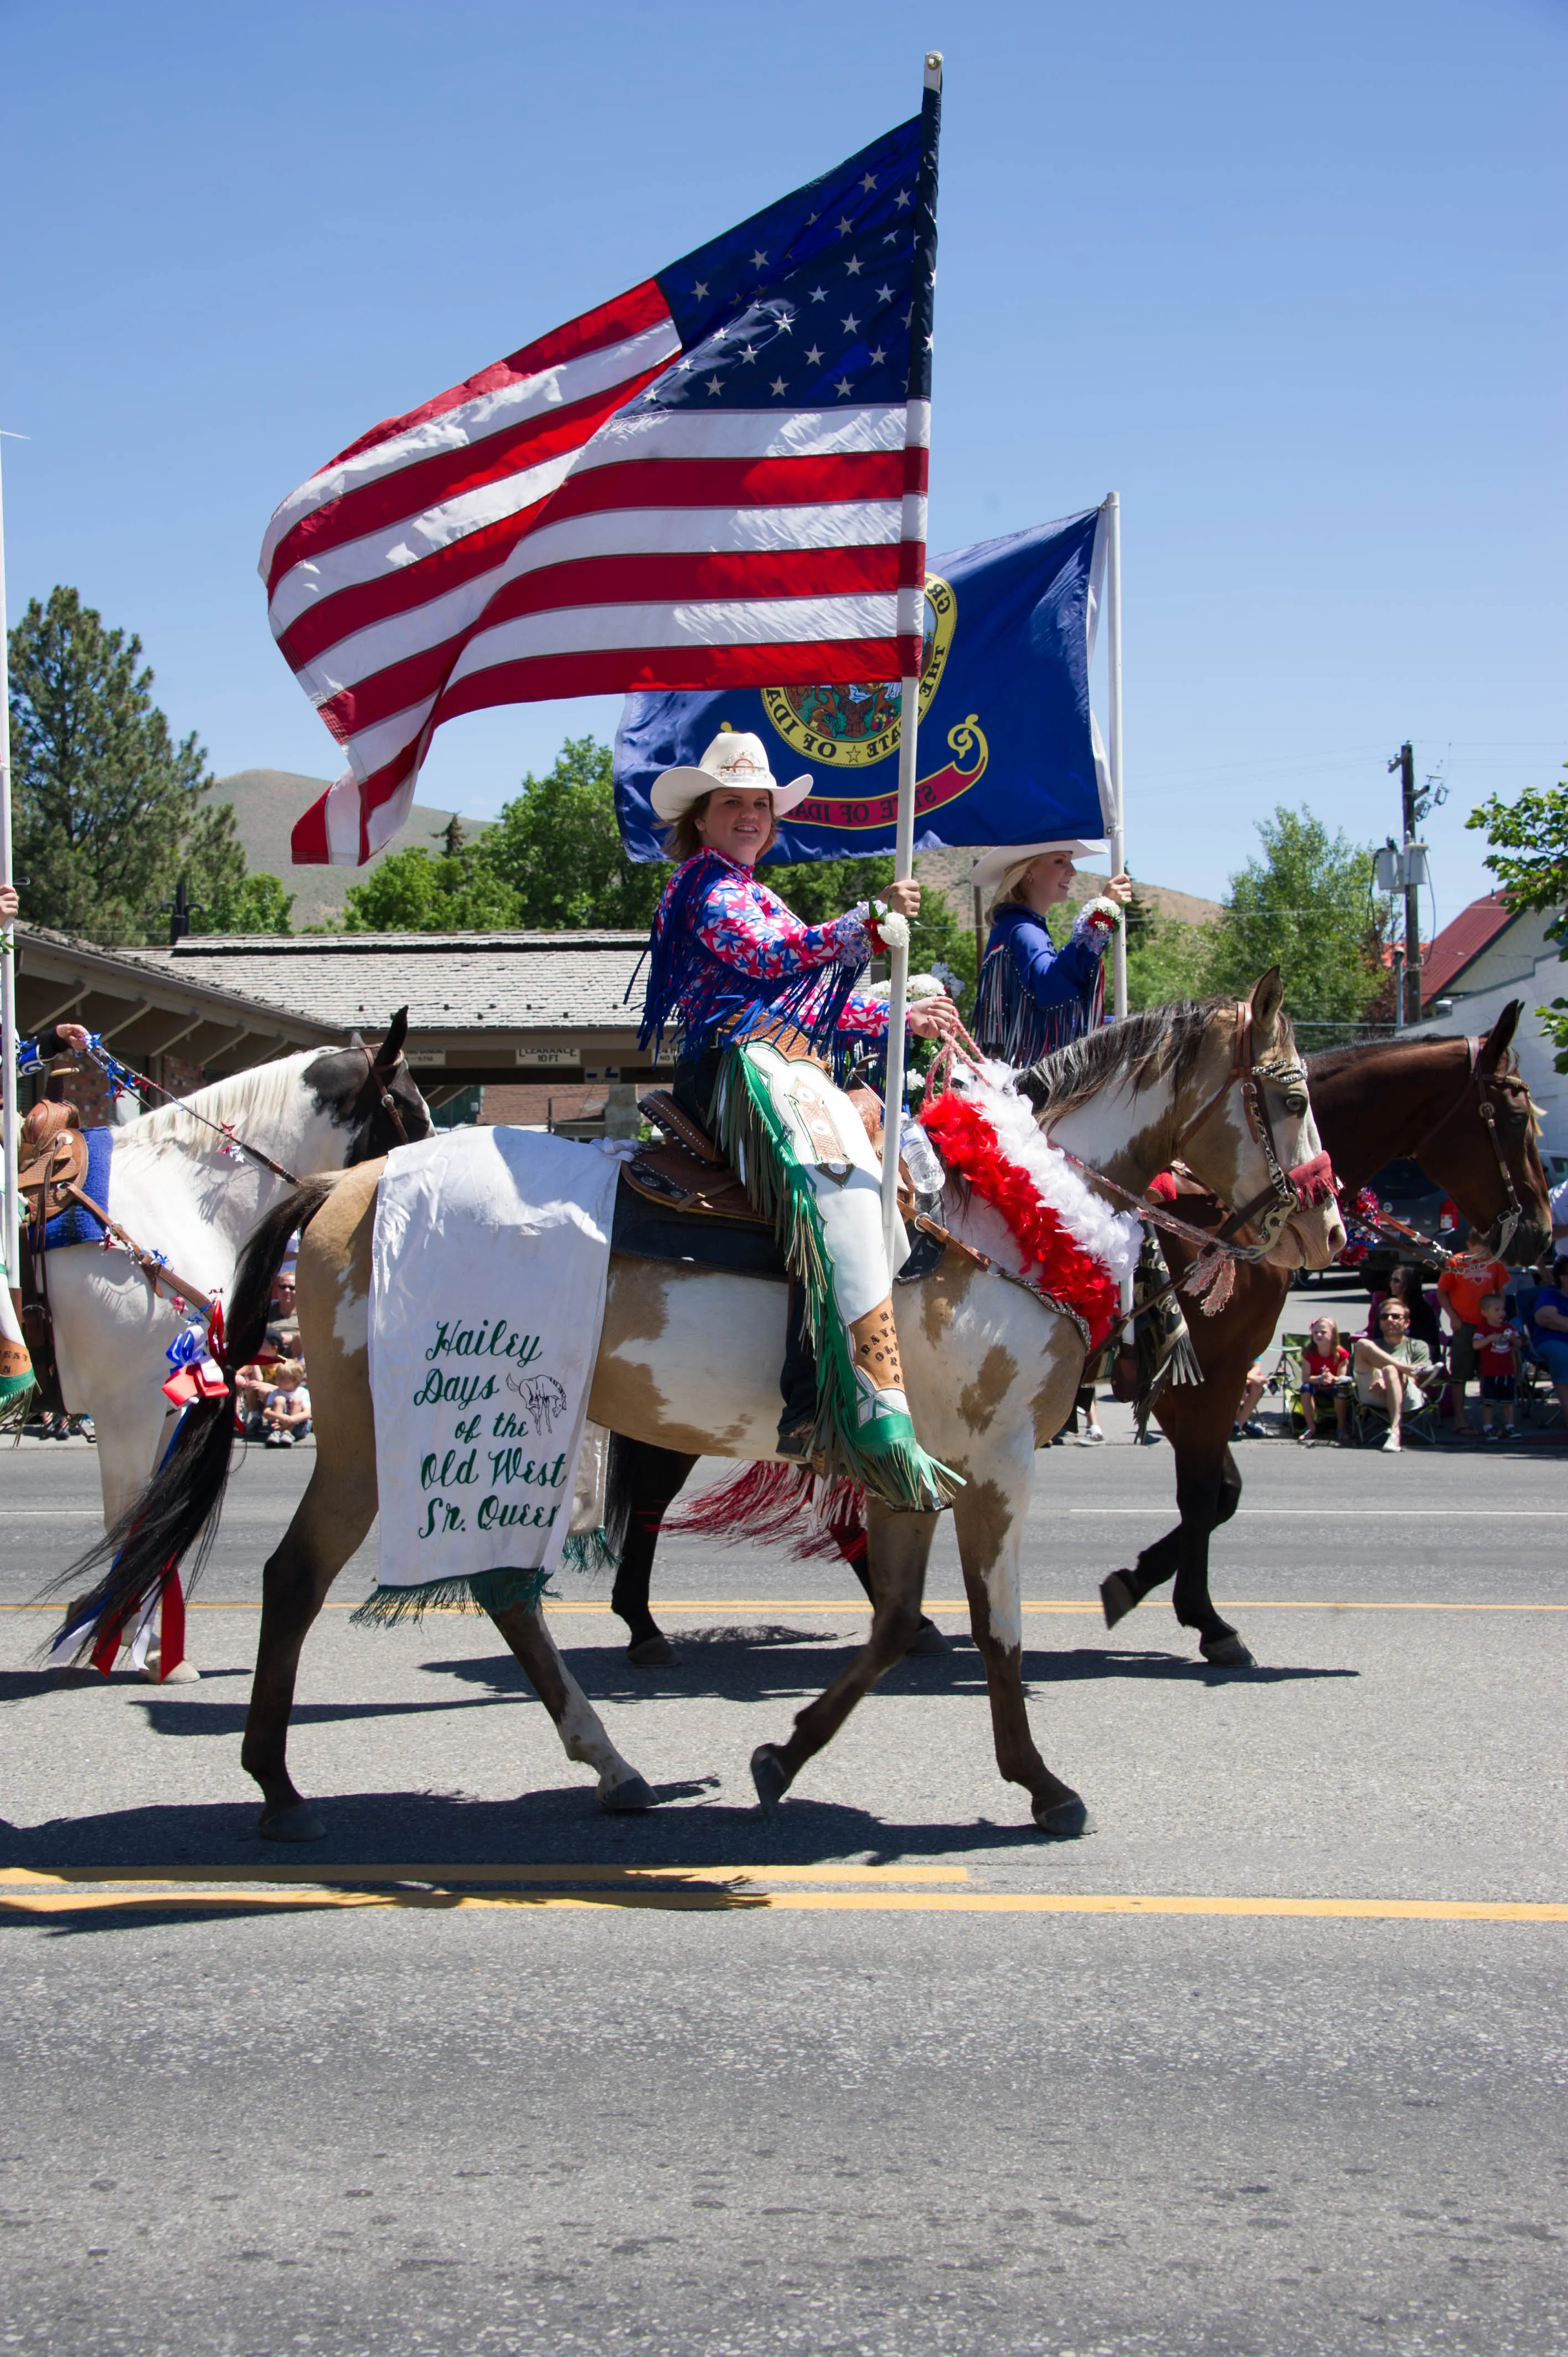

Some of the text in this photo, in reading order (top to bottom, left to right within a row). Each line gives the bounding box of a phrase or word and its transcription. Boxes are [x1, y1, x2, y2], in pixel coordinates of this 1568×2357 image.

[0, 1350, 28, 1361] EST
[425, 1320, 543, 1367] Hailey
[414, 1368, 499, 1410] Days
[455, 1412, 529, 1444] of the
[420, 1447, 566, 1490] Old West
[417, 1497, 466, 1538] Sr.
